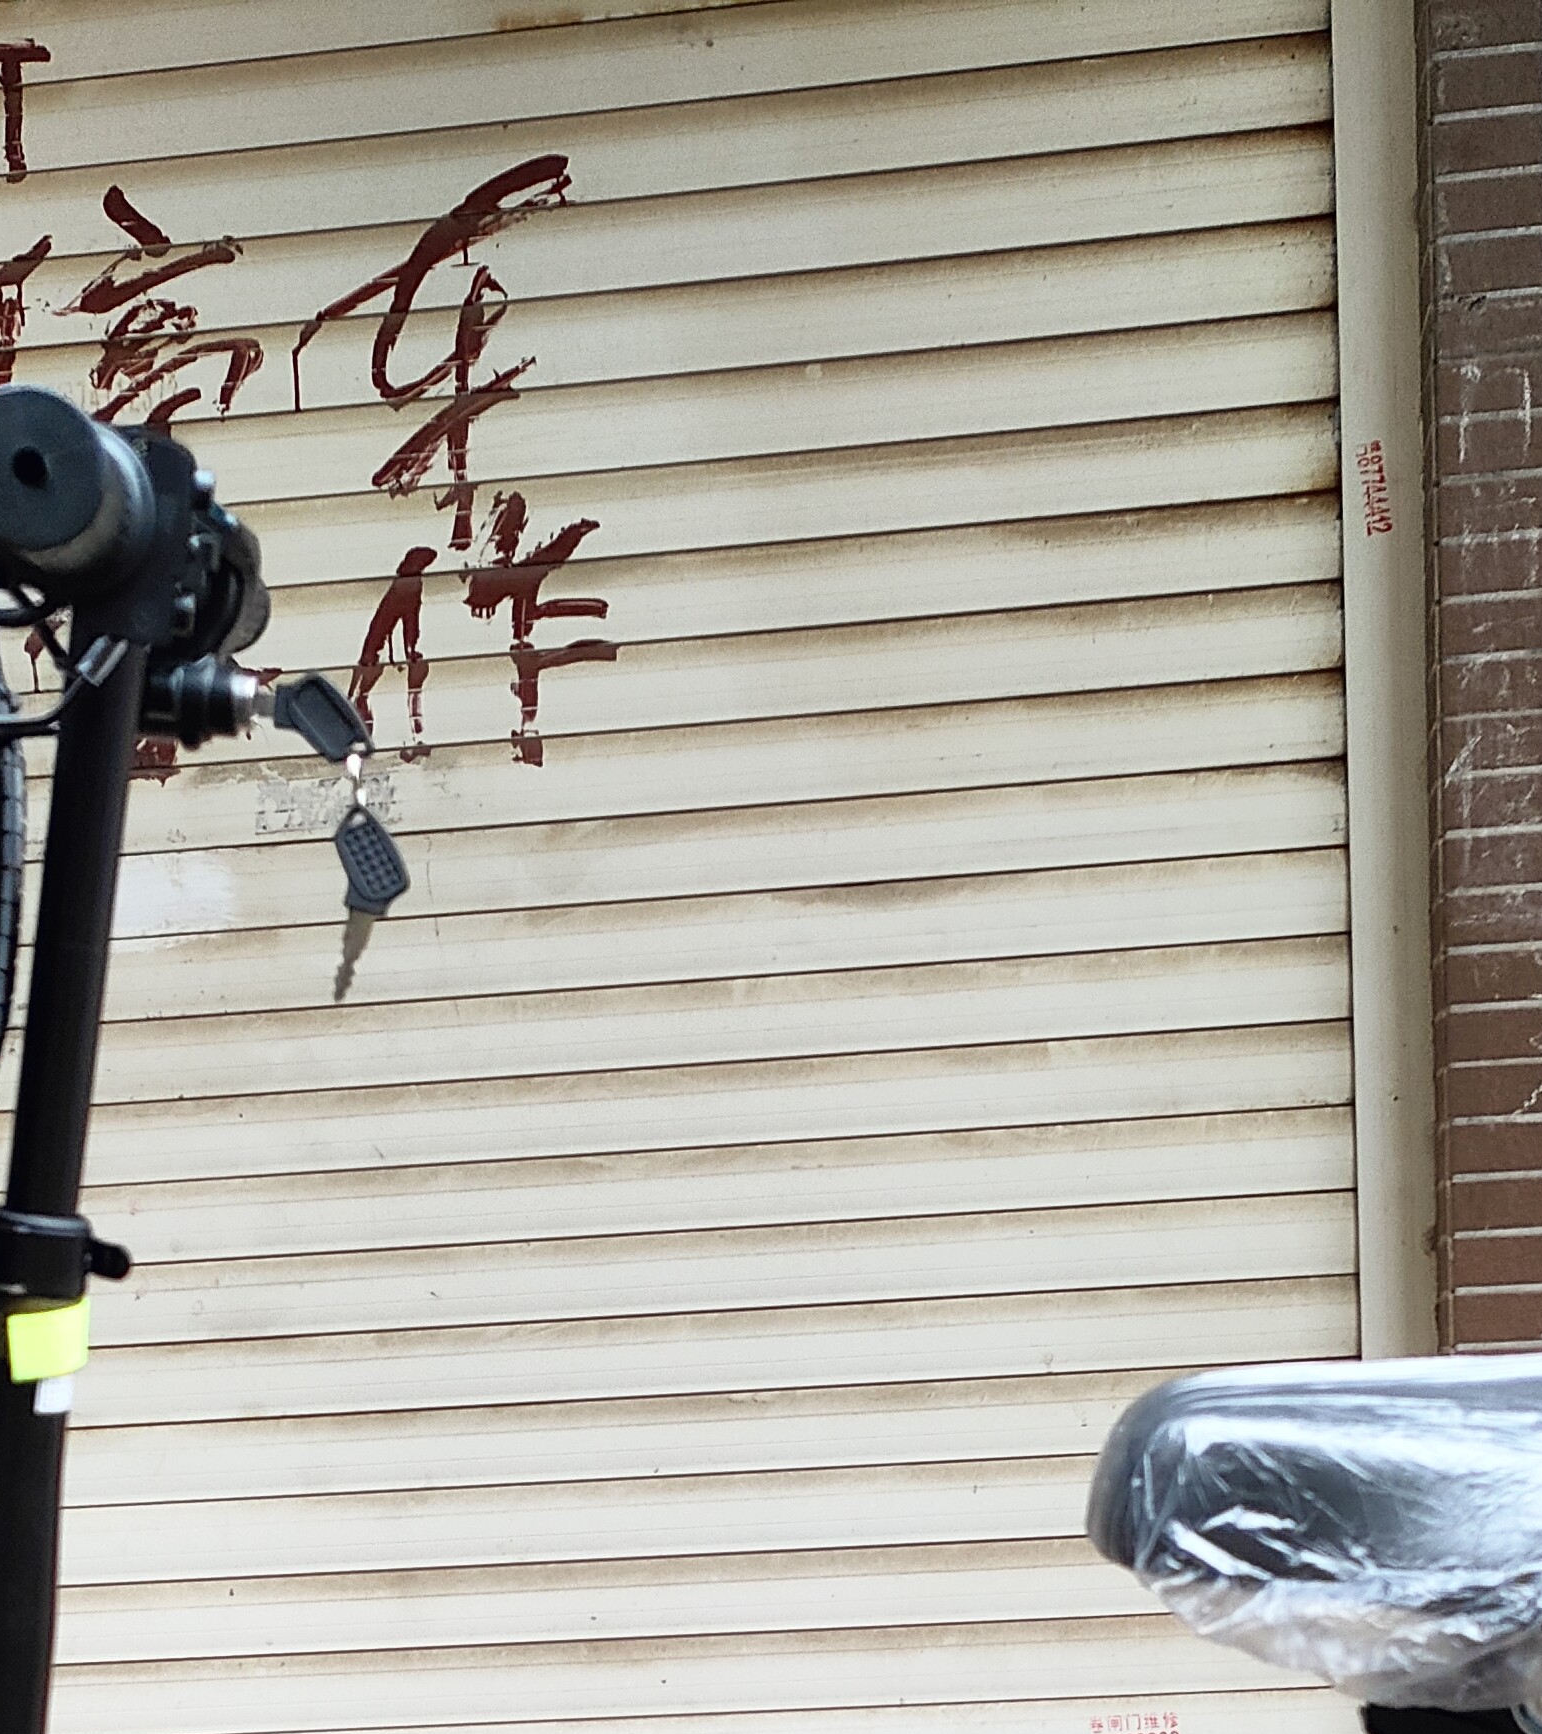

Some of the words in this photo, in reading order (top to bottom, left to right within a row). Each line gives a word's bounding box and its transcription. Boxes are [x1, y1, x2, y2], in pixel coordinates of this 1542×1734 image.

[1090, 1712, 1179, 1734] 卷闸门维修
